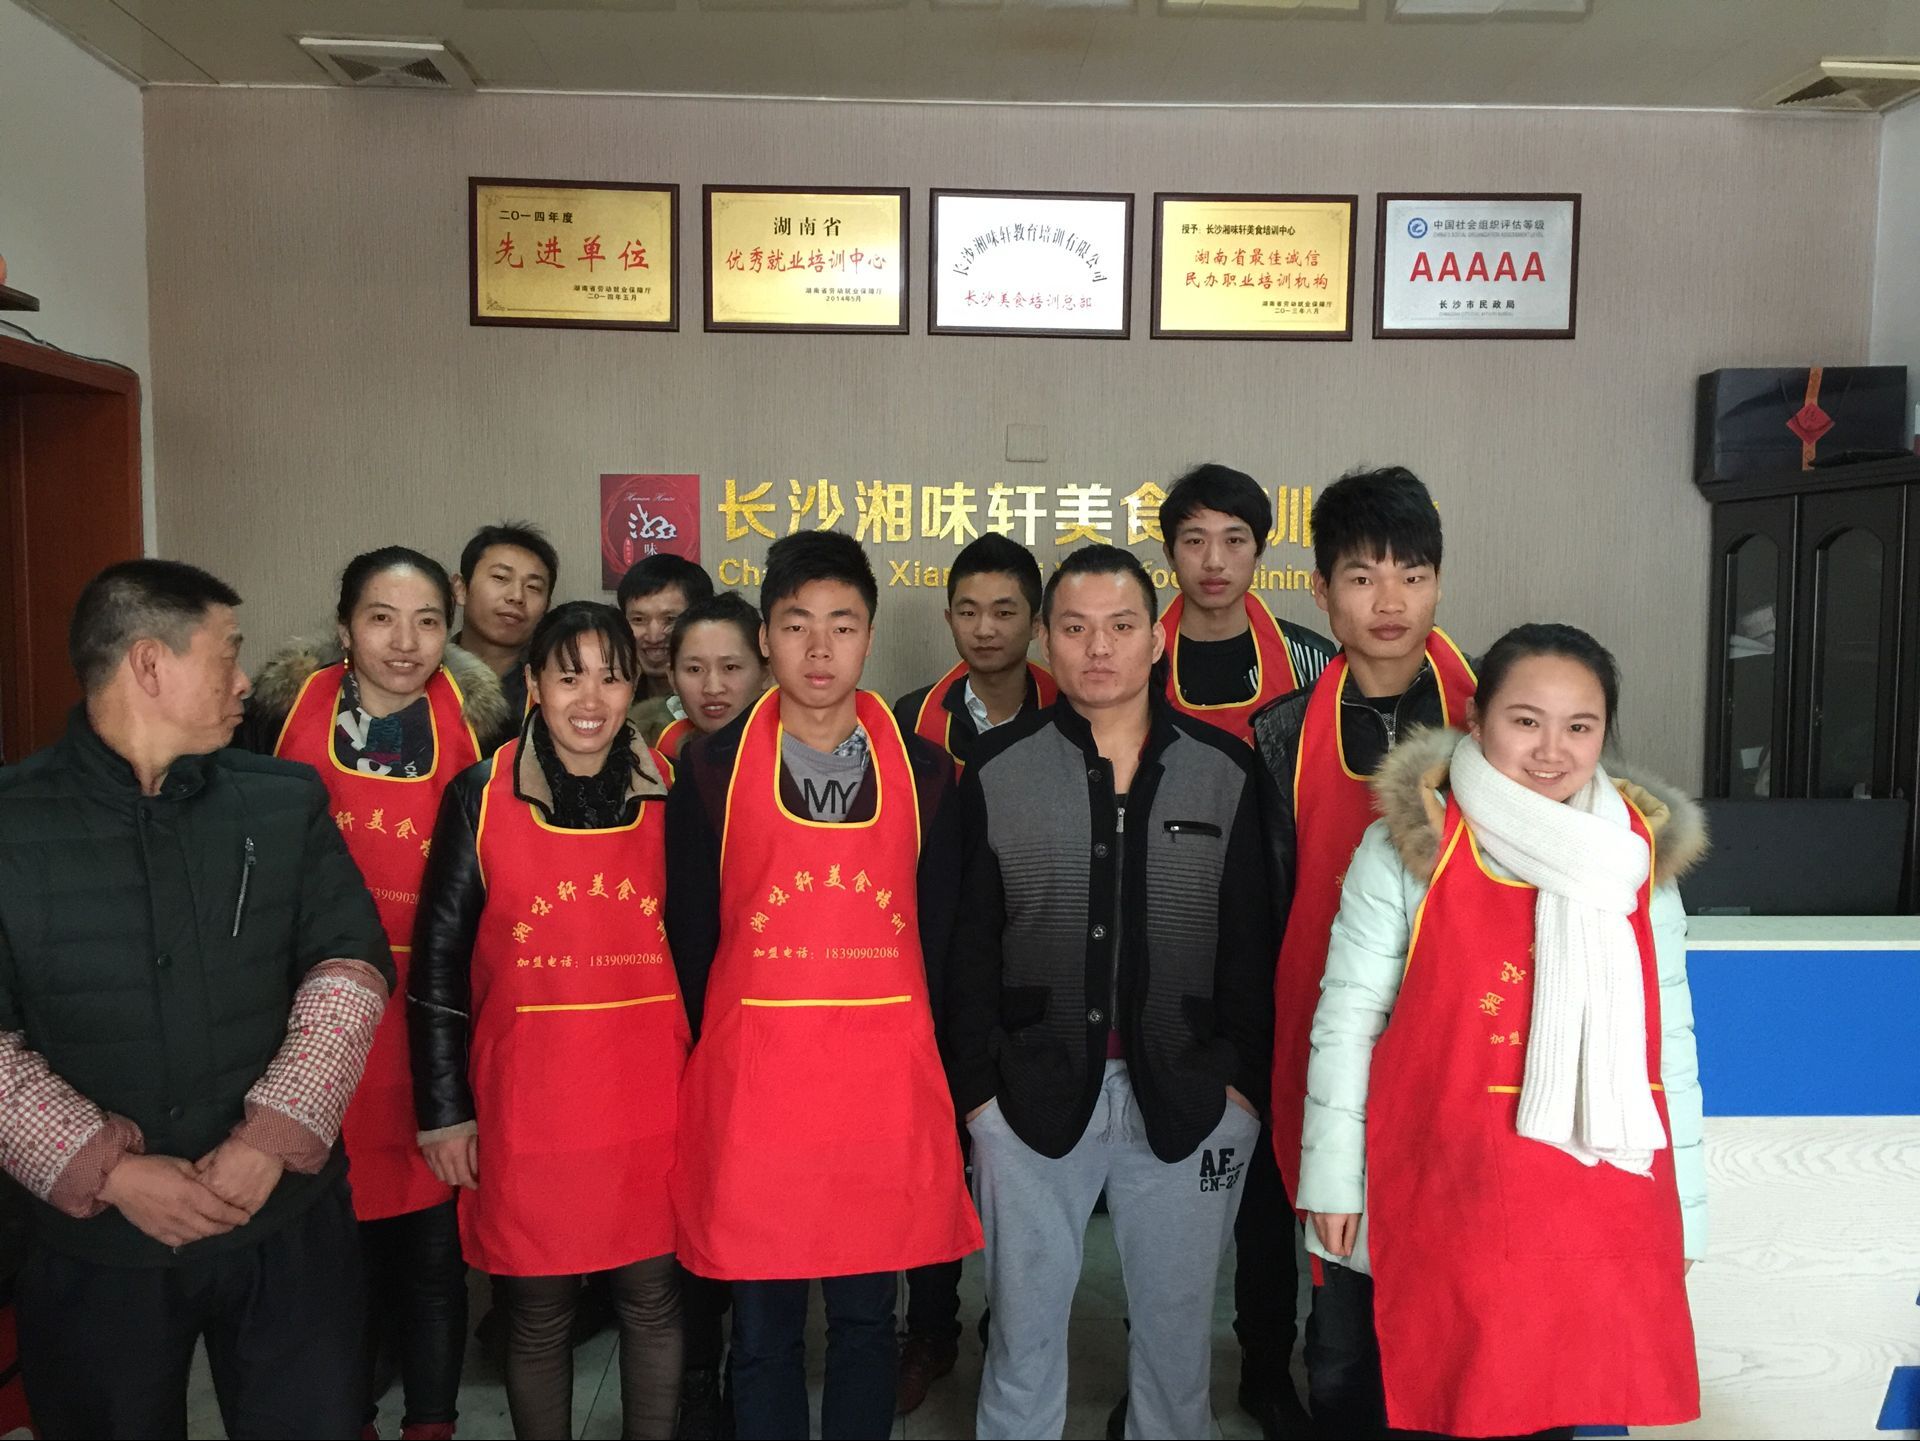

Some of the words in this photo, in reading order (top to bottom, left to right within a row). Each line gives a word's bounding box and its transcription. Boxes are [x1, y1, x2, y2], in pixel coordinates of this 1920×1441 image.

[774, 216, 841, 236] 湖南省
[1206, 224, 1296, 235] 长沙湘味轩美食培训中心
[1433, 219, 1545, 231] 中国社会组织评估等级
[494, 232, 649, 272] 先进单位
[726, 246, 887, 274] 优秀就业培训中心
[953, 223, 1108, 283] 长沙湘味轩教育培训有限公司
[1194, 248, 1321, 266] 湖南省最佳诚信
[1409, 251, 1546, 282] AAAAA
[1185, 272, 1329, 290] 民办职业培训机构
[964, 289, 1092, 311] 长沙美食培训总部
[1439, 300, 1515, 309] 长沙市民政局
[750, 863, 906, 936] 湘味轩美食培训
[589, 953, 663, 967] 18390902086
[825, 947, 899, 960] 18390902086
